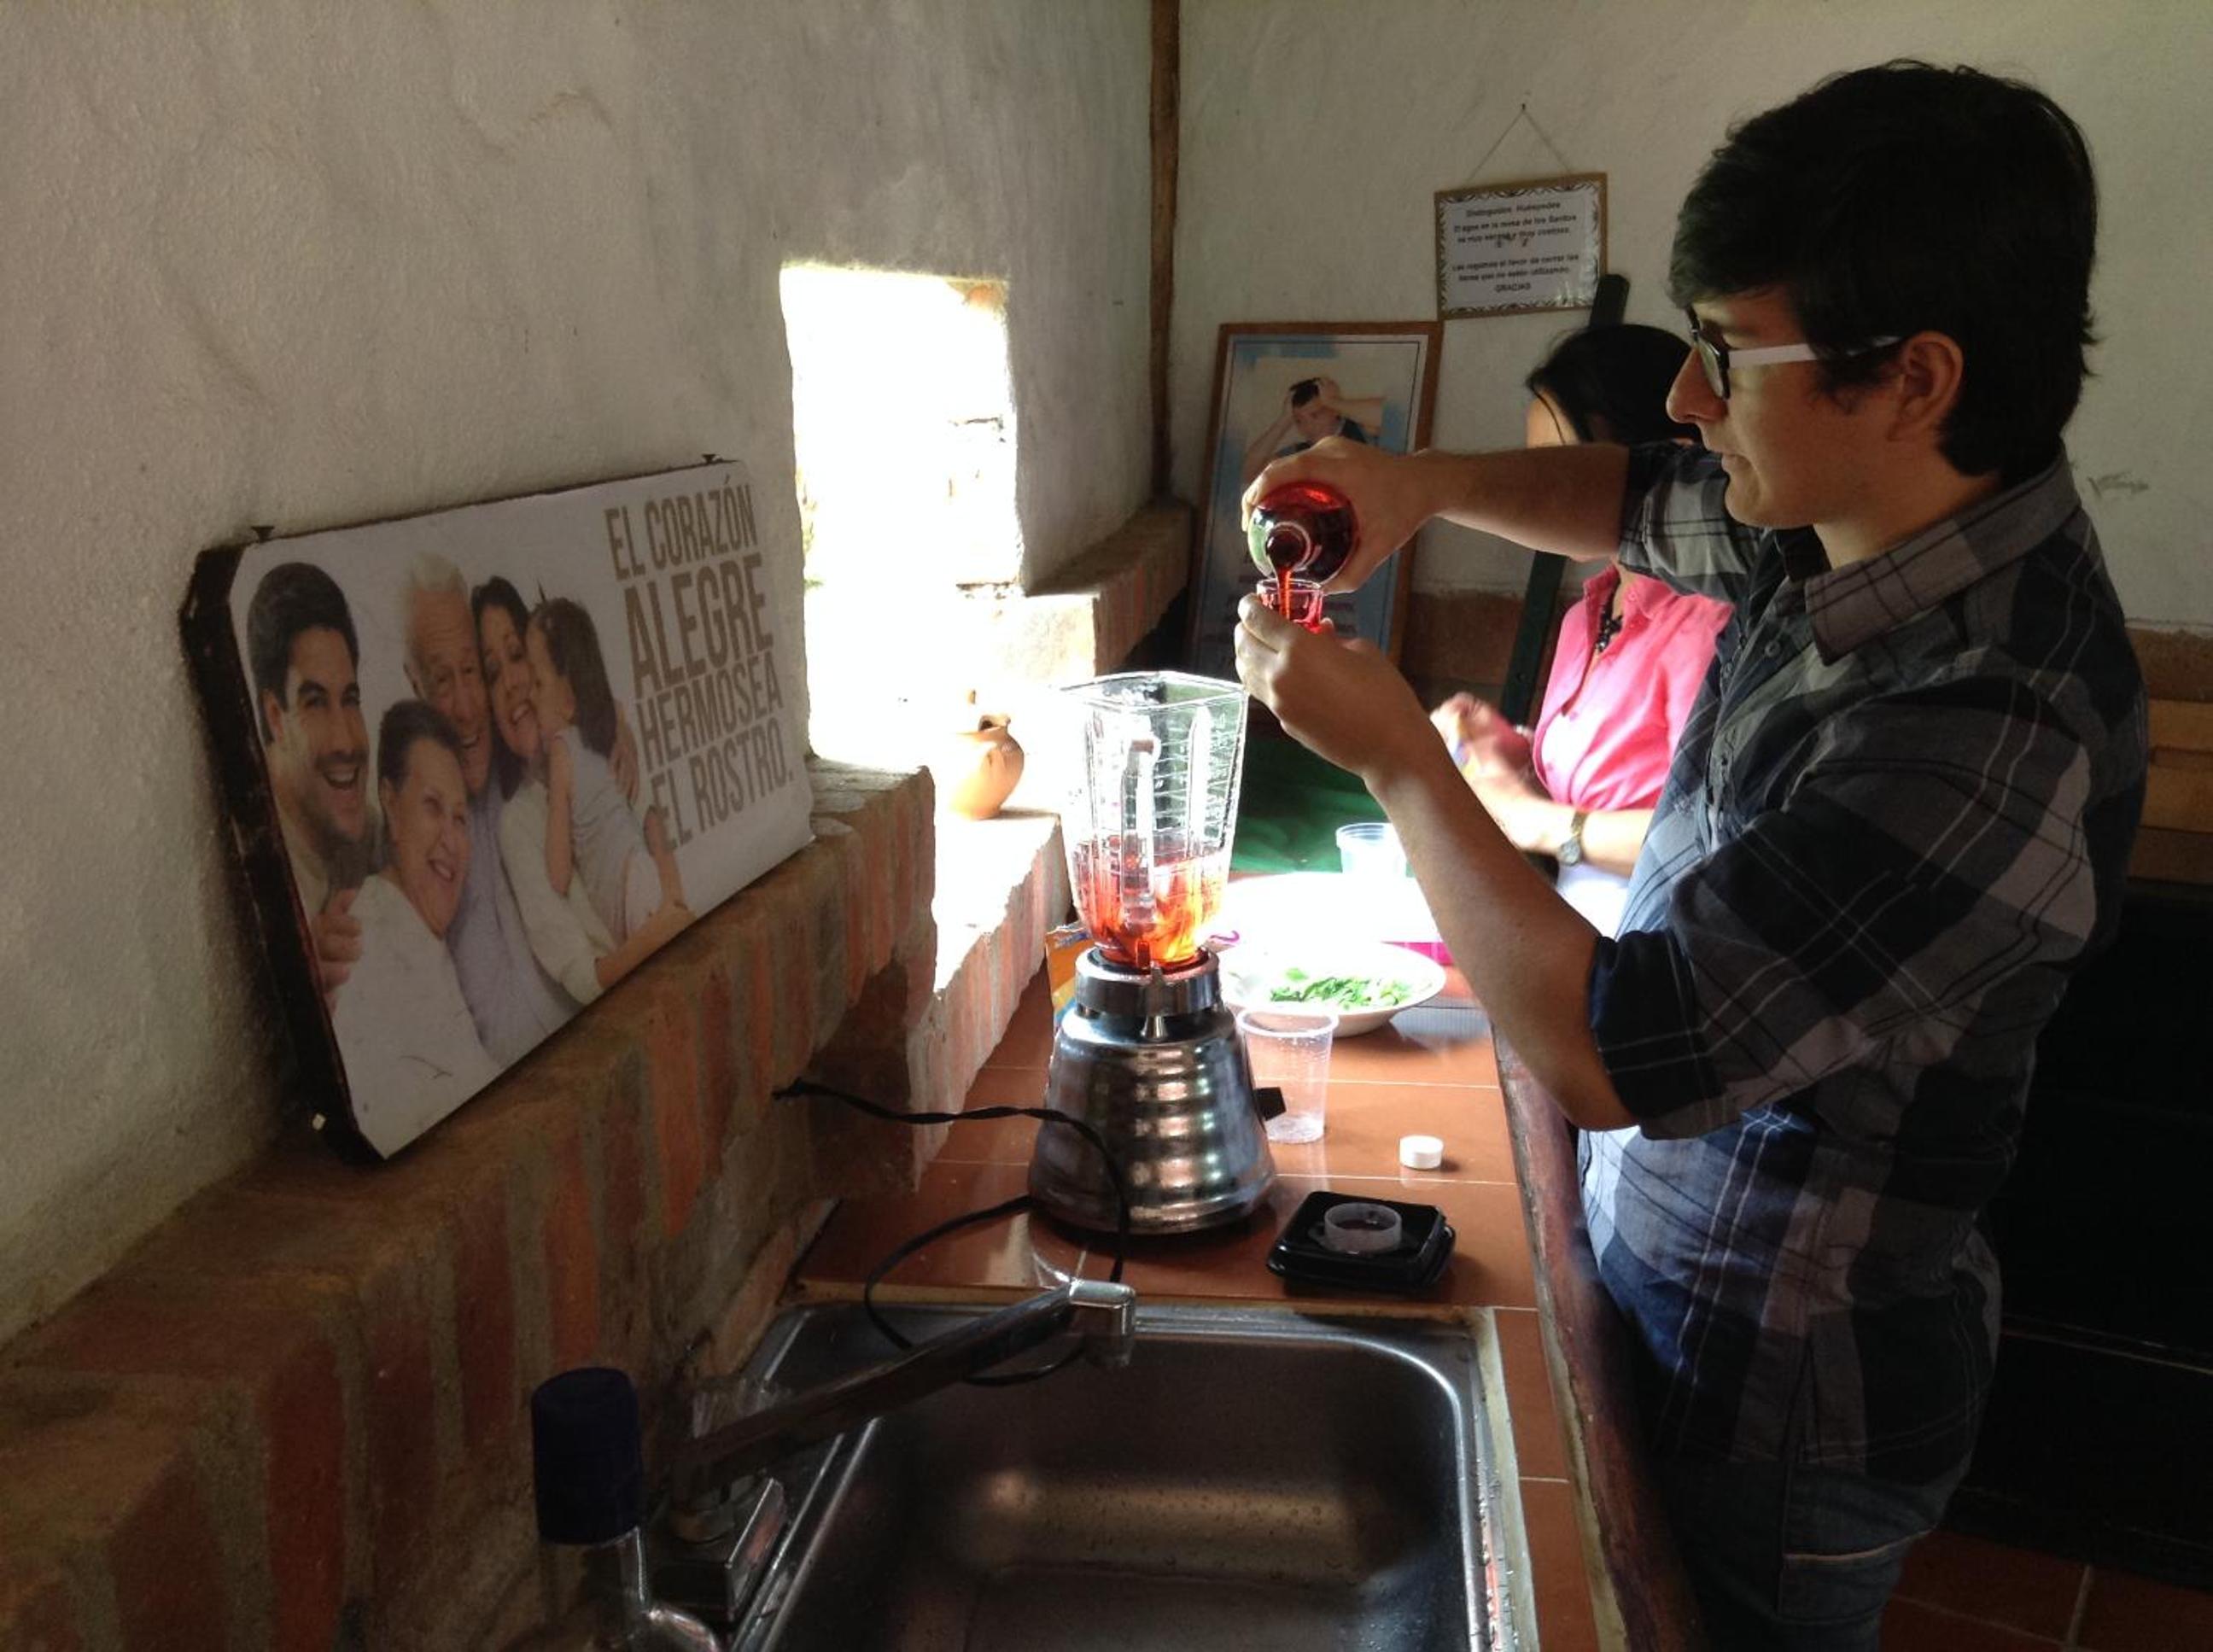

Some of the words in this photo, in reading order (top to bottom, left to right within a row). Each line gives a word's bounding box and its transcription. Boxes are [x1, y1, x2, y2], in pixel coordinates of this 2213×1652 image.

[1495, 282, 1532, 293] GRACIAS
[604, 505, 645, 581] EL
[645, 474, 759, 570] CORAZÓN
[624, 552, 774, 700] ALEGRE
[636, 651, 785, 770] HERMOSEA
[651, 768, 693, 850] EL
[691, 717, 795, 834] ROSTRO.
